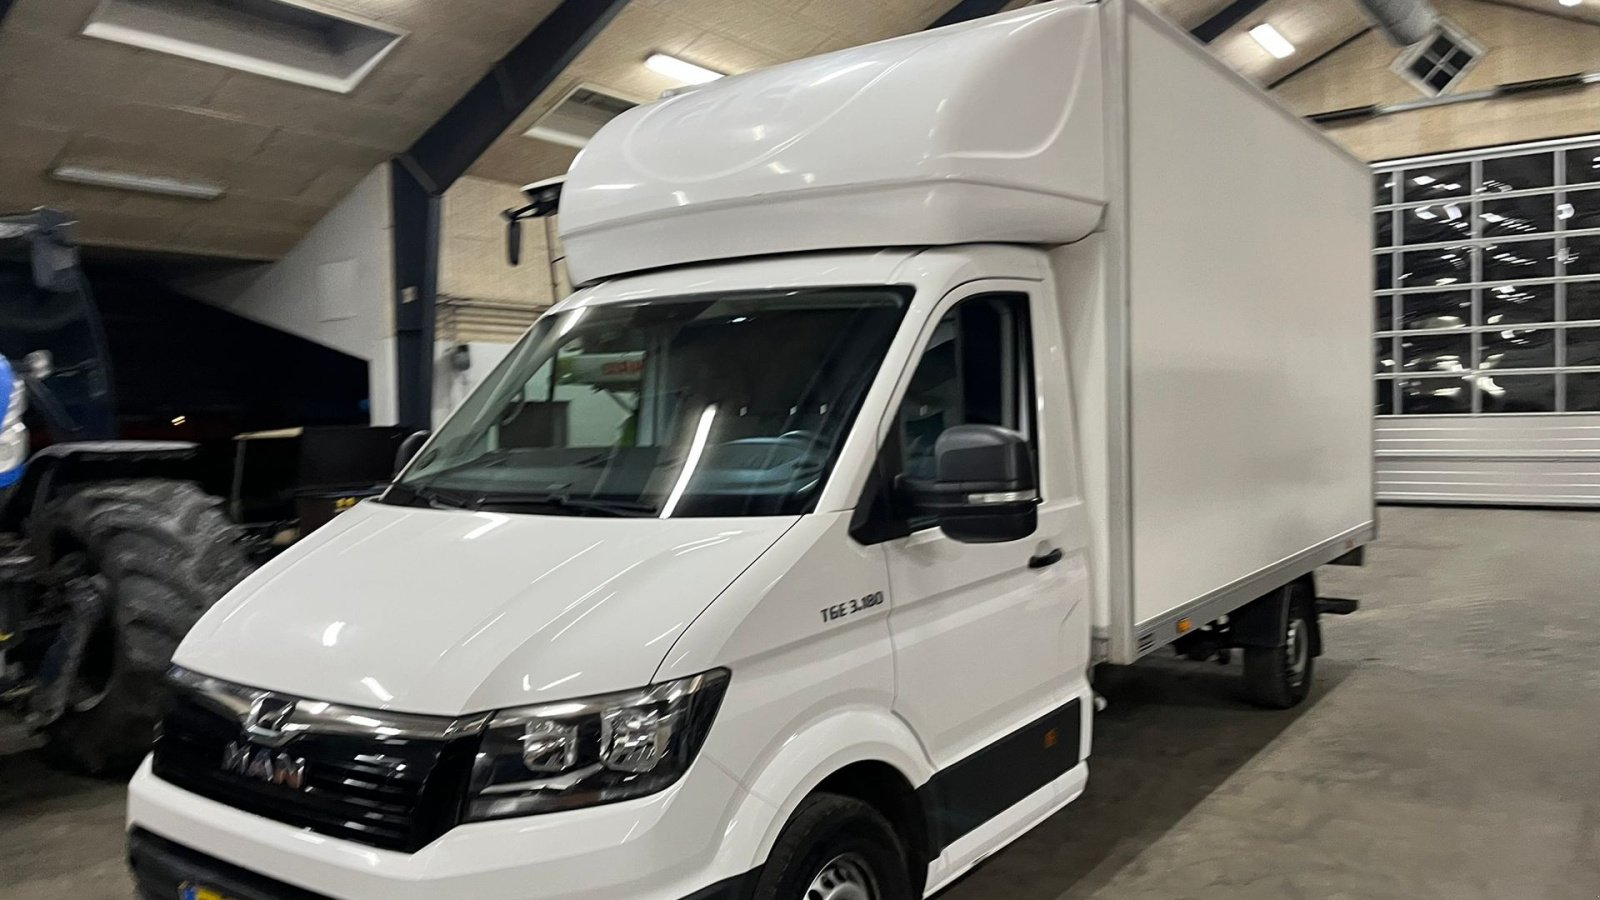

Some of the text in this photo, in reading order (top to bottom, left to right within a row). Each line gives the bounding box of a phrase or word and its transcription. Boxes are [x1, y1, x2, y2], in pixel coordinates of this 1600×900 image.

[820, 590, 884, 623] TGE 3.180
[221, 740, 305, 789] MAN
